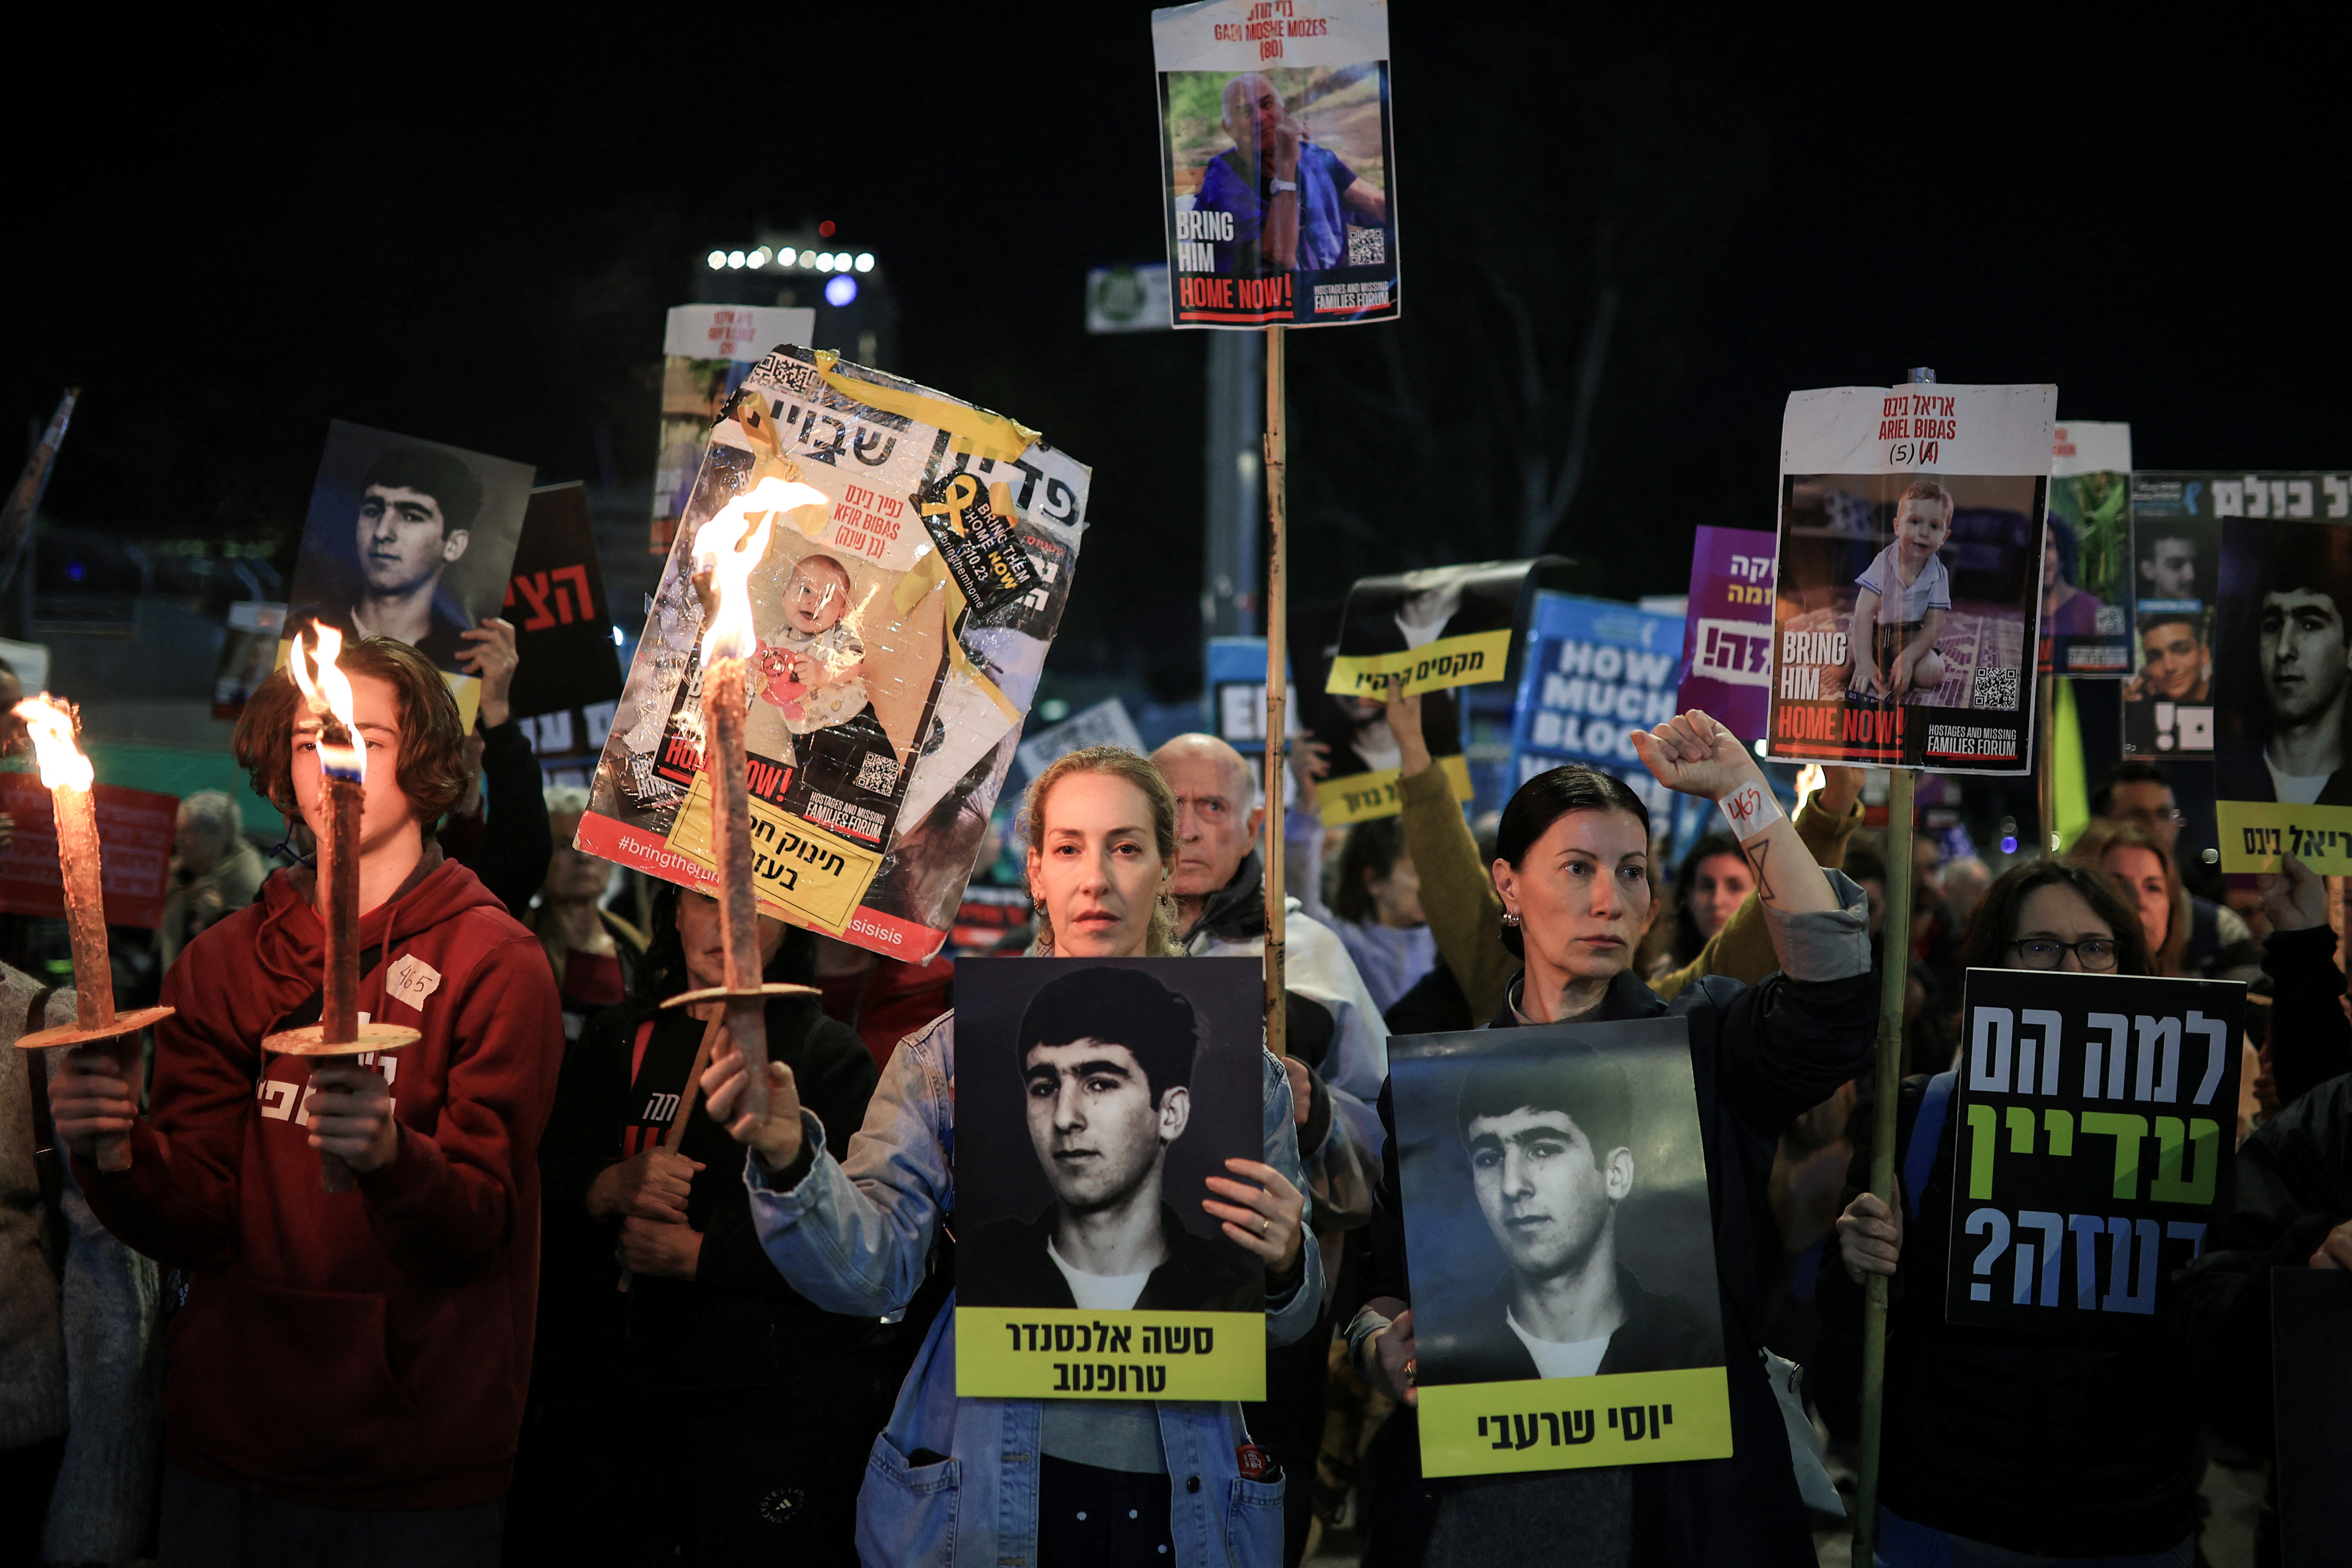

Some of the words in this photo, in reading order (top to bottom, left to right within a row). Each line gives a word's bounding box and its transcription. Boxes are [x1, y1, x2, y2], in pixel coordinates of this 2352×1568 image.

[1214, 24, 1242, 41] GADI
[1246, 20, 1284, 41] MOSHE
[1288, 18, 1327, 37] MOZES
[1259, 39, 1283, 61] (80)
[1176, 210, 1234, 241] BRING
[1178, 242, 1215, 273] HIM
[1179, 277, 1234, 308] HOME
[1239, 273, 1293, 309] NOW!
[1314, 294, 1356, 309] FAMILIES
[1357, 291, 1389, 306] FORUM
[1347, 283, 1360, 293] AND
[1360, 281, 1389, 292] MISSING
[1883, 396, 1908, 417] ביבס
[1913, 394, 1955, 416] אריאל
[750, 399, 897, 466] שבויי
[1879, 419, 1910, 440] ARIEL
[1914, 418, 1956, 440] BIBAS
[1890, 443, 1914, 465] (5)
[845, 484, 875, 509] ביבס
[877, 495, 904, 518] כפיר
[2211, 475, 2314, 518] כולם
[834, 503, 862, 527] KFIR
[862, 513, 900, 540] BIBAS
[965, 511, 994, 551] HOME
[988, 551, 1017, 589] NOW
[977, 503, 1007, 544] BRING
[1004, 545, 1031, 583] THEM
[1559, 640, 1674, 687] HOW
[1703, 627, 1770, 676] זה!
[1782, 631, 1847, 666] BRING
[1416, 650, 1484, 682] מקסים
[1781, 666, 1820, 700] HIM
[1543, 674, 1677, 723] MUCH
[1531, 710, 1639, 762] BLOO
[1778, 706, 1837, 740] HOME
[1843, 707, 1905, 745] NOW!
[1929, 724, 1966, 737] HOSTAGES
[1967, 727, 1981, 738] AND
[1983, 728, 2016, 741] MISSING
[1928, 736, 1975, 755] FAMILIES
[1977, 739, 2016, 756] FORUM
[747, 759, 793, 802] OW!
[805, 802, 848, 829] FAMILIES
[848, 816, 883, 840] FORUM
[810, 791, 844, 811] HOSTAGES
[842, 802, 857, 815] AND
[856, 806, 886, 825] MISSING
[1728, 788, 1761, 821] 465
[775, 832, 845, 877] תינוק
[2243, 827, 2282, 855] ביבס
[2289, 824, 2352, 858] ריאל
[752, 849, 798, 891] בעז
[398, 965, 432, 992] 465
[1969, 1006, 2062, 1096] הם
[2082, 1010, 2227, 1106] למה
[1967, 1103, 2220, 1205] עדיין
[1006, 1320, 1132, 1354] אלכסנדר
[1142, 1325, 1214, 1355] סשה
[1053, 1363, 1167, 1393] טרופנוב
[1477, 1409, 1596, 1452] שרעבי
[1608, 1404, 1673, 1442] יוסי
